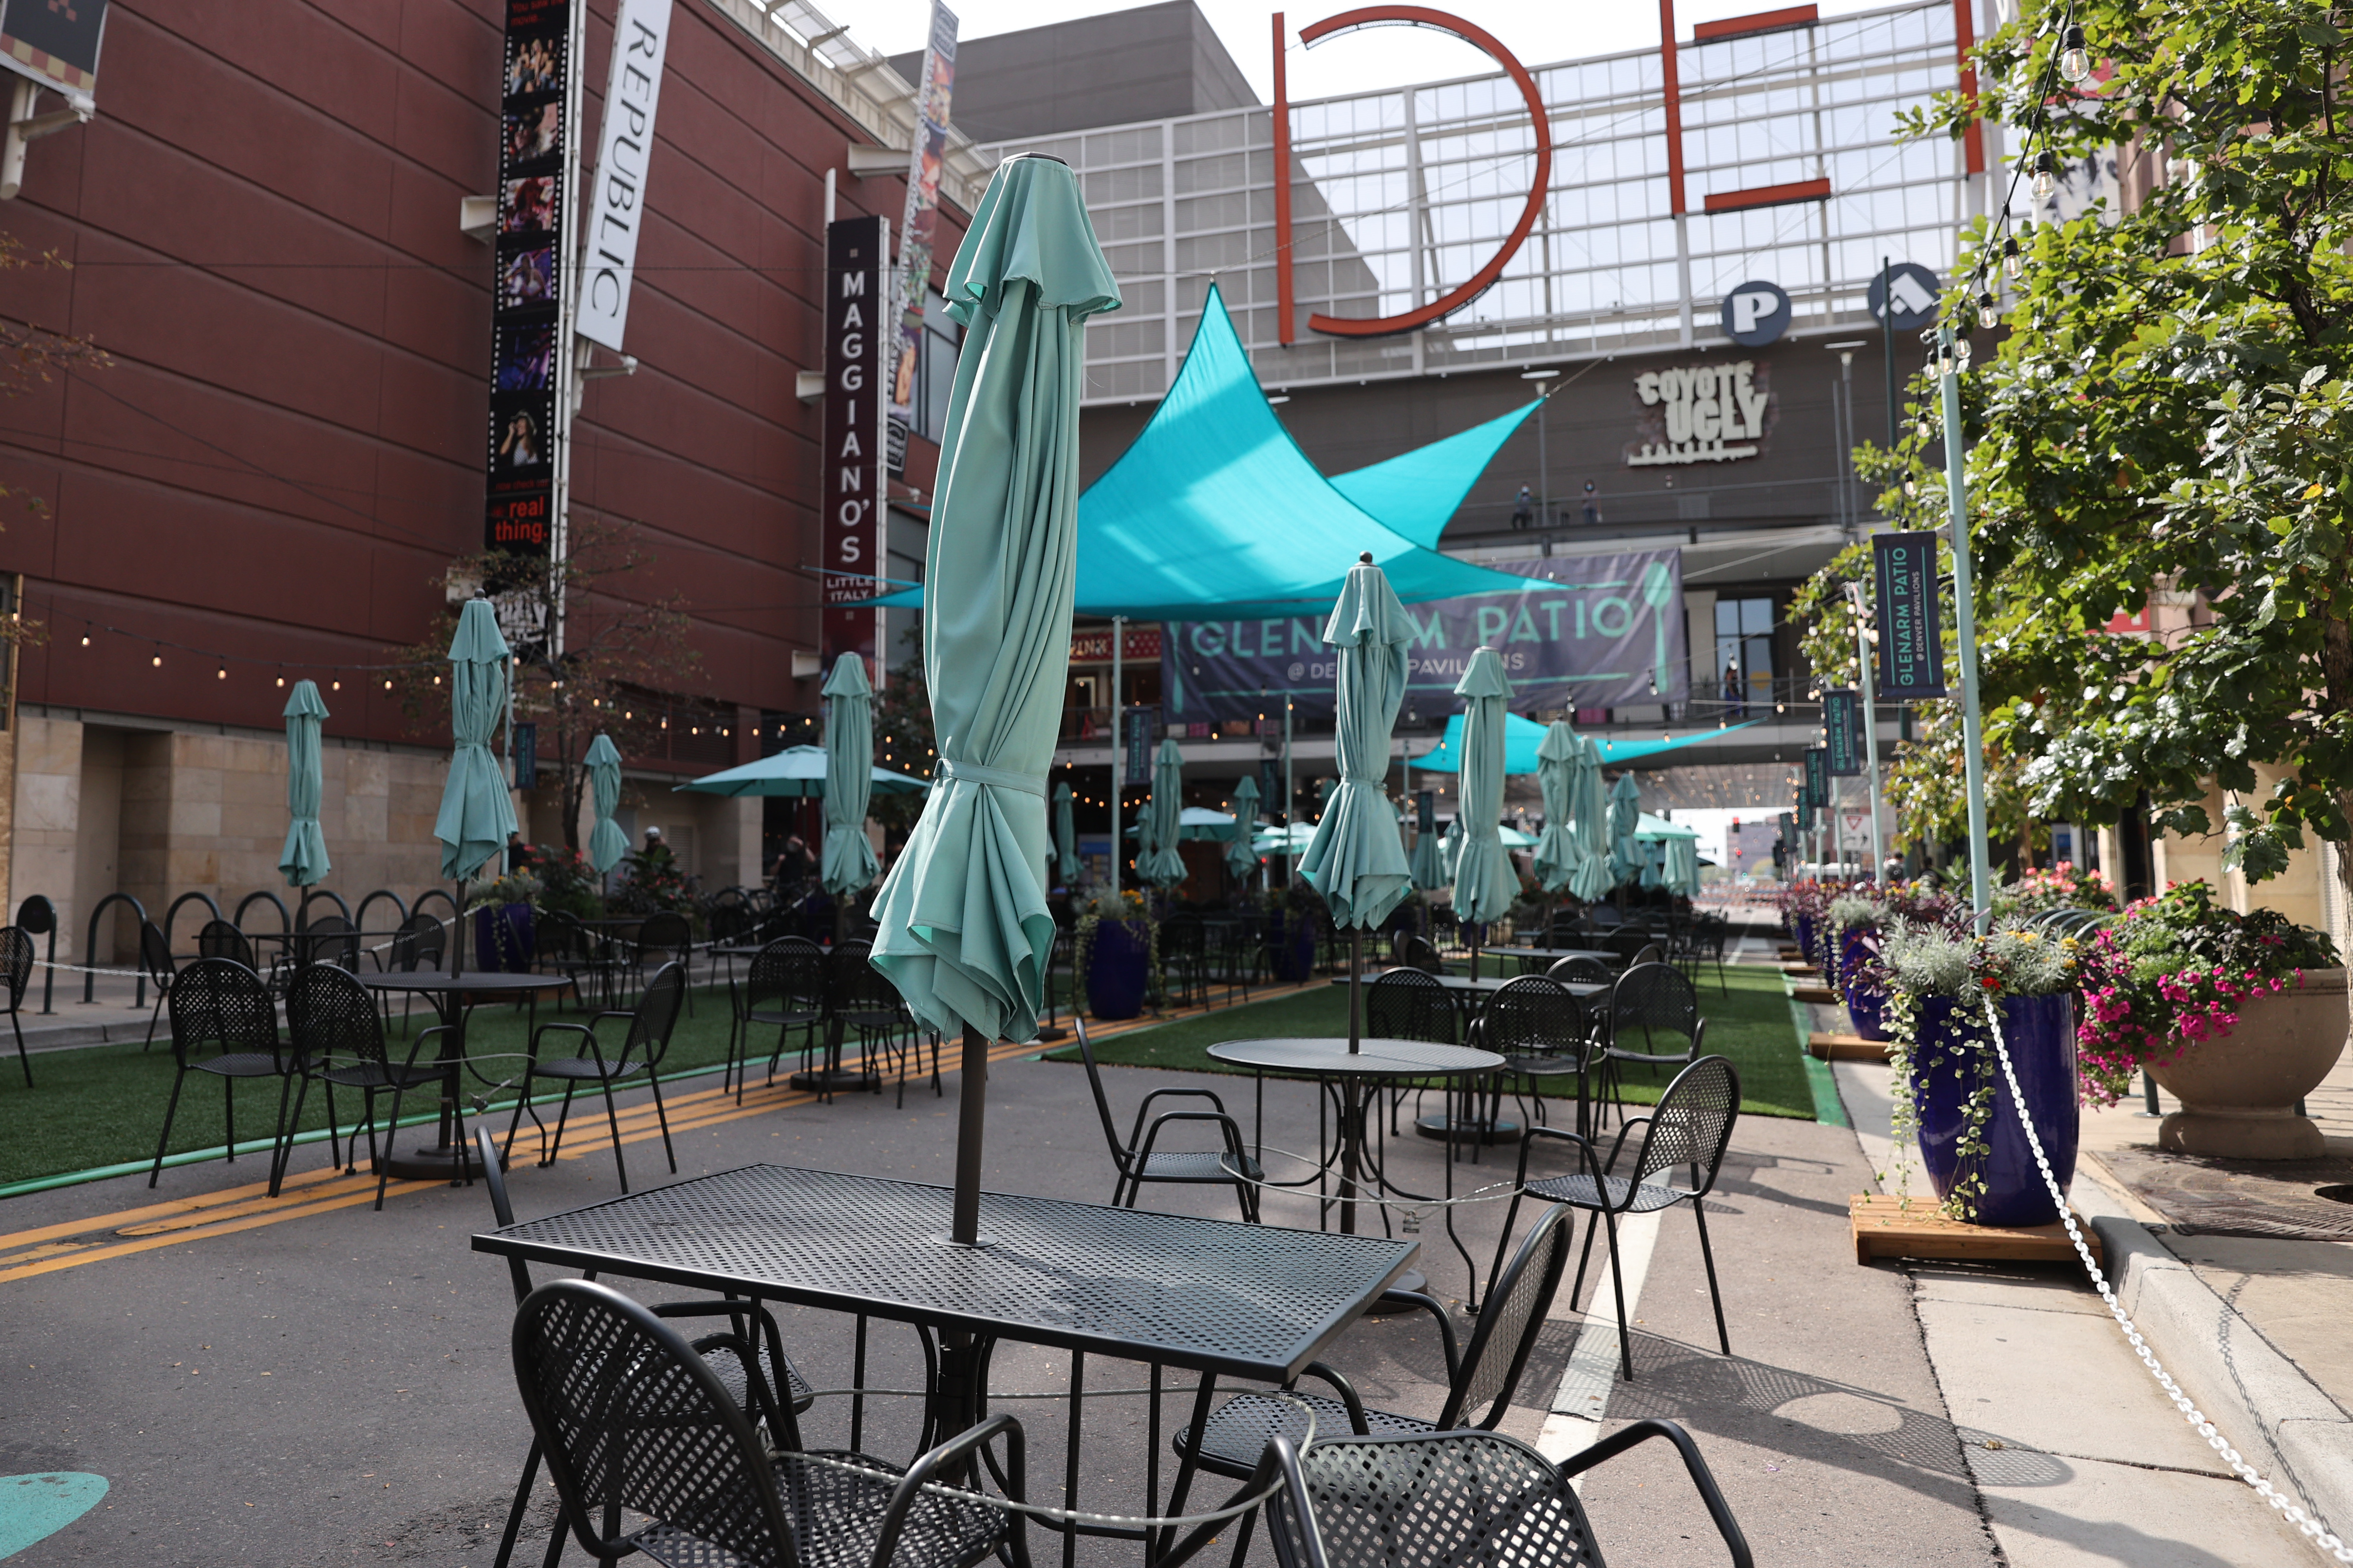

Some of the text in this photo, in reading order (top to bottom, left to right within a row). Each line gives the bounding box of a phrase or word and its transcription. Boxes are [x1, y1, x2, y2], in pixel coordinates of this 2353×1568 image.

[591, 17, 657, 318] REPUBLIC
[1733, 291, 1779, 333] P
[1634, 361, 1754, 405] COYOTE
[839, 269, 871, 564] MAGGIANO'S
[1665, 392, 1769, 444] UGLY
[509, 495, 544, 518] real
[495, 519, 548, 544] thing.
[826, 576, 874, 588] LITTLE
[830, 588, 869, 602] ITALY
[1912, 571, 1922, 616] PAVILIONS
[1191, 596, 1633, 658] GLENM PATIO
[1892, 547, 1915, 686] GLENARM PATIO
[1914, 618, 1924, 652] DENVER
[1287, 662, 1305, 681] @
[1408, 652, 1525, 676] PAVILNS
